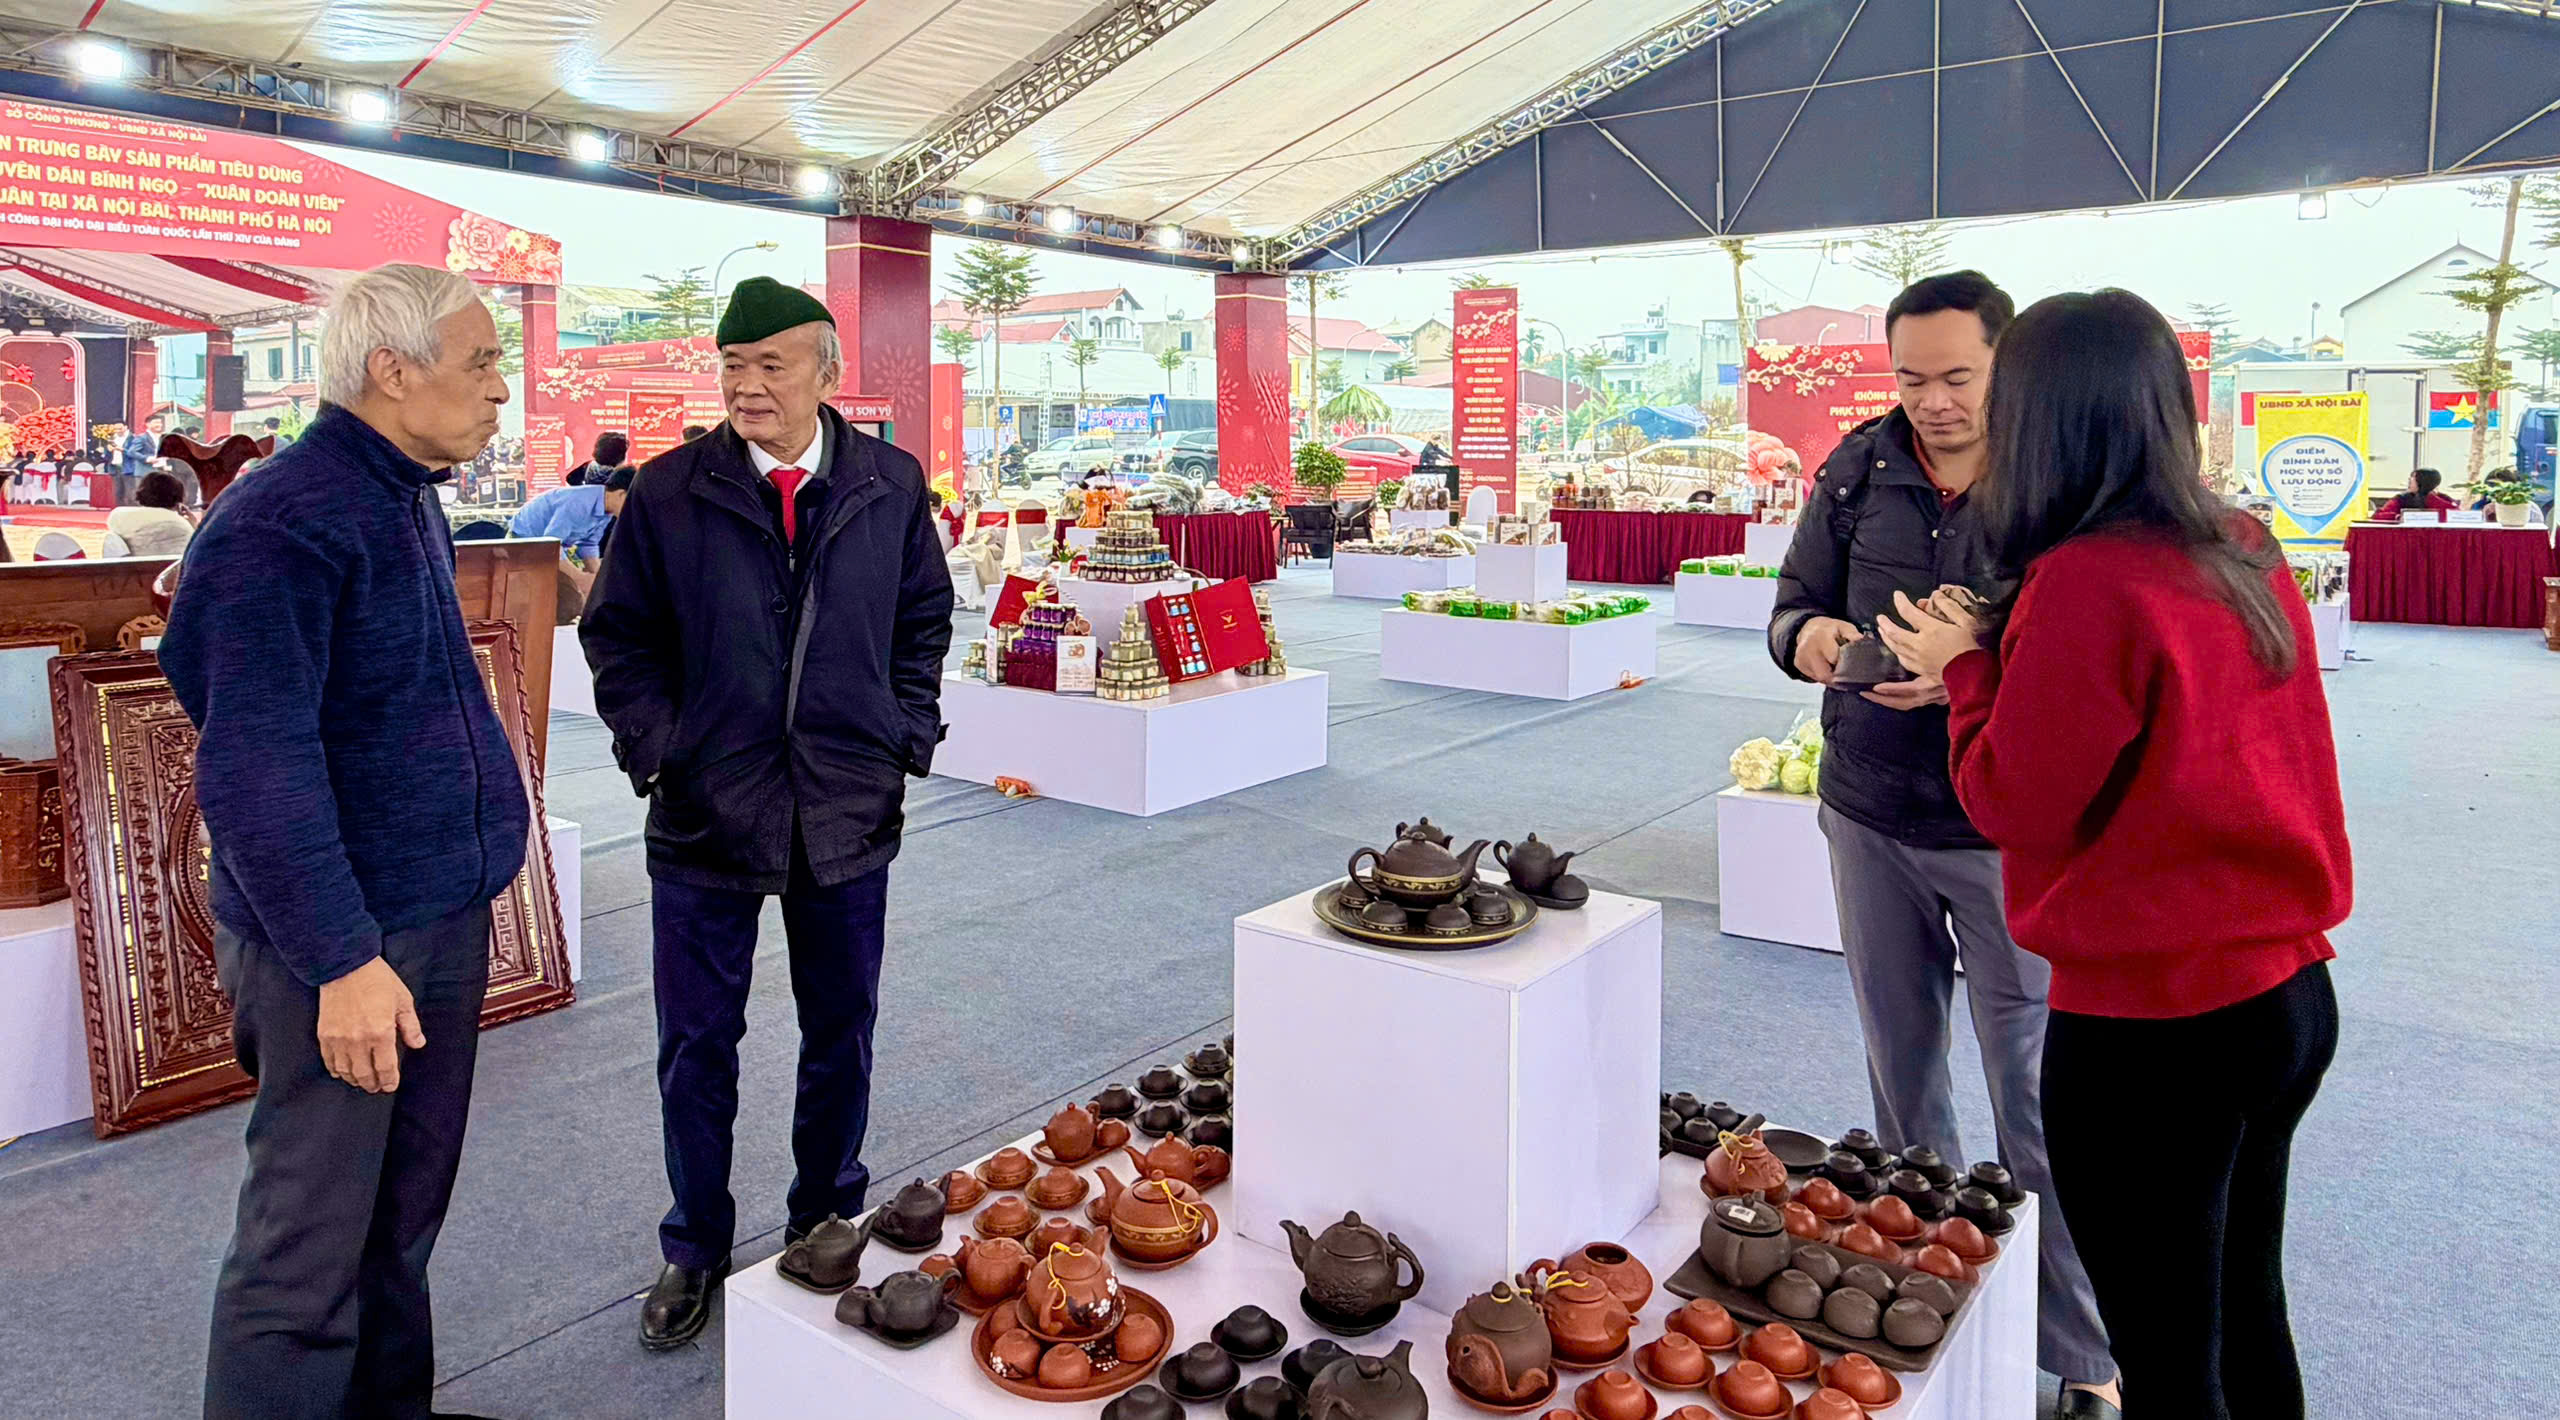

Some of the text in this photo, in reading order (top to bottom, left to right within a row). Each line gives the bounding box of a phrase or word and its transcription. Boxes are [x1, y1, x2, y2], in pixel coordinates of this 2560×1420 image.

[119, 123, 148, 135] UBND
[168, 129, 188, 141] NỘI
[16, 136, 81, 159] TRƯNG
[85, 144, 121, 163] BÀY
[126, 148, 161, 168] SẢN
[166, 151, 215, 174] PHẨM
[219, 160, 254, 178] TIÊU
[258, 163, 304, 184] DÙNG
[139, 175, 178, 195] NGỌ
[254, 187, 300, 207] ĐOÀN
[38, 191, 67, 210] TẠI
[72, 192, 99, 213] XÃ
[103, 196, 135, 216] NỘI
[177, 204, 234, 224] THÀNH
[239, 209, 275, 228] PHỐ
[278, 214, 300, 231] HÀ
[304, 217, 332, 234] NỘI
[8, 212, 40, 226] CÔNG
[162, 226, 191, 239] QUỐC
[2260, 397, 2362, 409] UBND XÃ NỘI BÀI
[2296, 446, 2326, 455] ĐIỂM
[2283, 457, 2340, 465] BÌNH DÂN
[2280, 466, 2344, 476] HỌC VỤ SỐ
[2307, 477, 2342, 486] ĐỘNG
